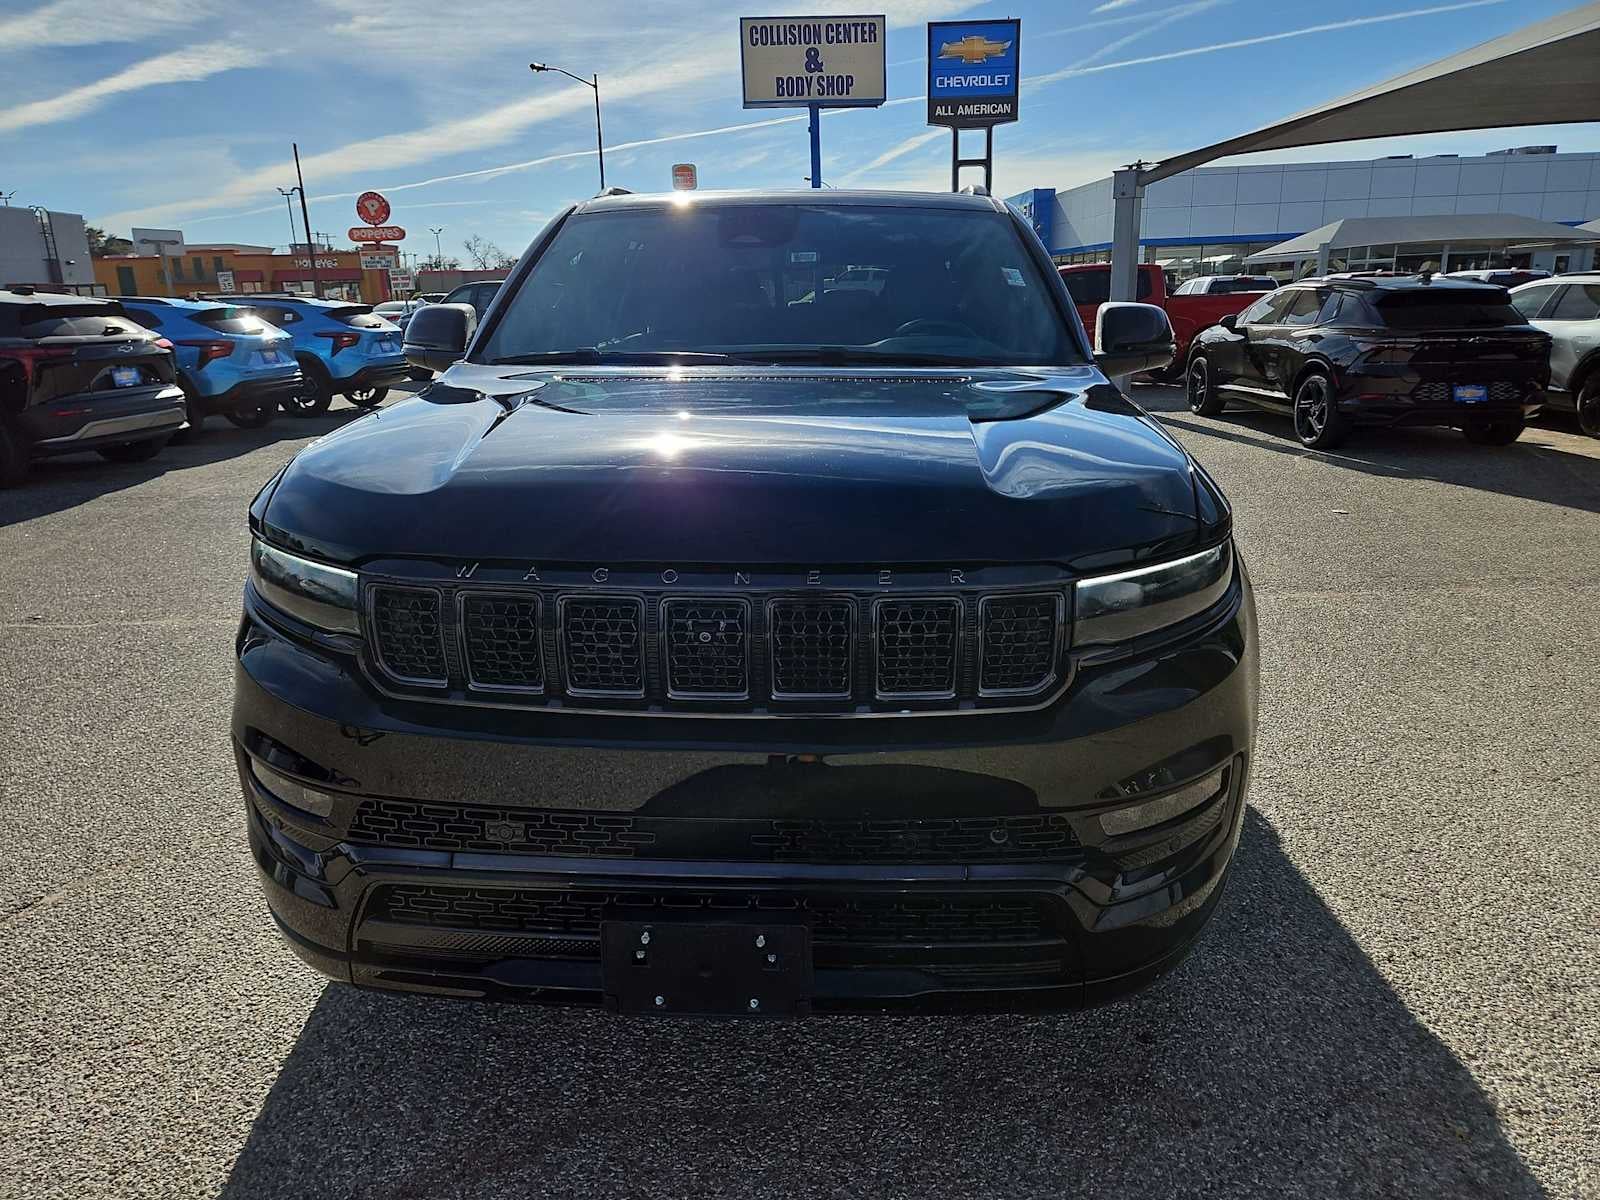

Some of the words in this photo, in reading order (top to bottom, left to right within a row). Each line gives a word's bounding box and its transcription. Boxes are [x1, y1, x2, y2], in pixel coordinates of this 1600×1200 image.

[749, 24, 822, 47] COLLISION
[825, 22, 878, 45] CENTER
[805, 47, 824, 73] &
[775, 75, 813, 97] BODY
[816, 75, 854, 96] SHOP
[936, 74, 1011, 88] CHEVROLET
[935, 105, 955, 116] ALL
[957, 103, 1012, 115] AMERICAN
[455, 562, 966, 585] WAGONEER
